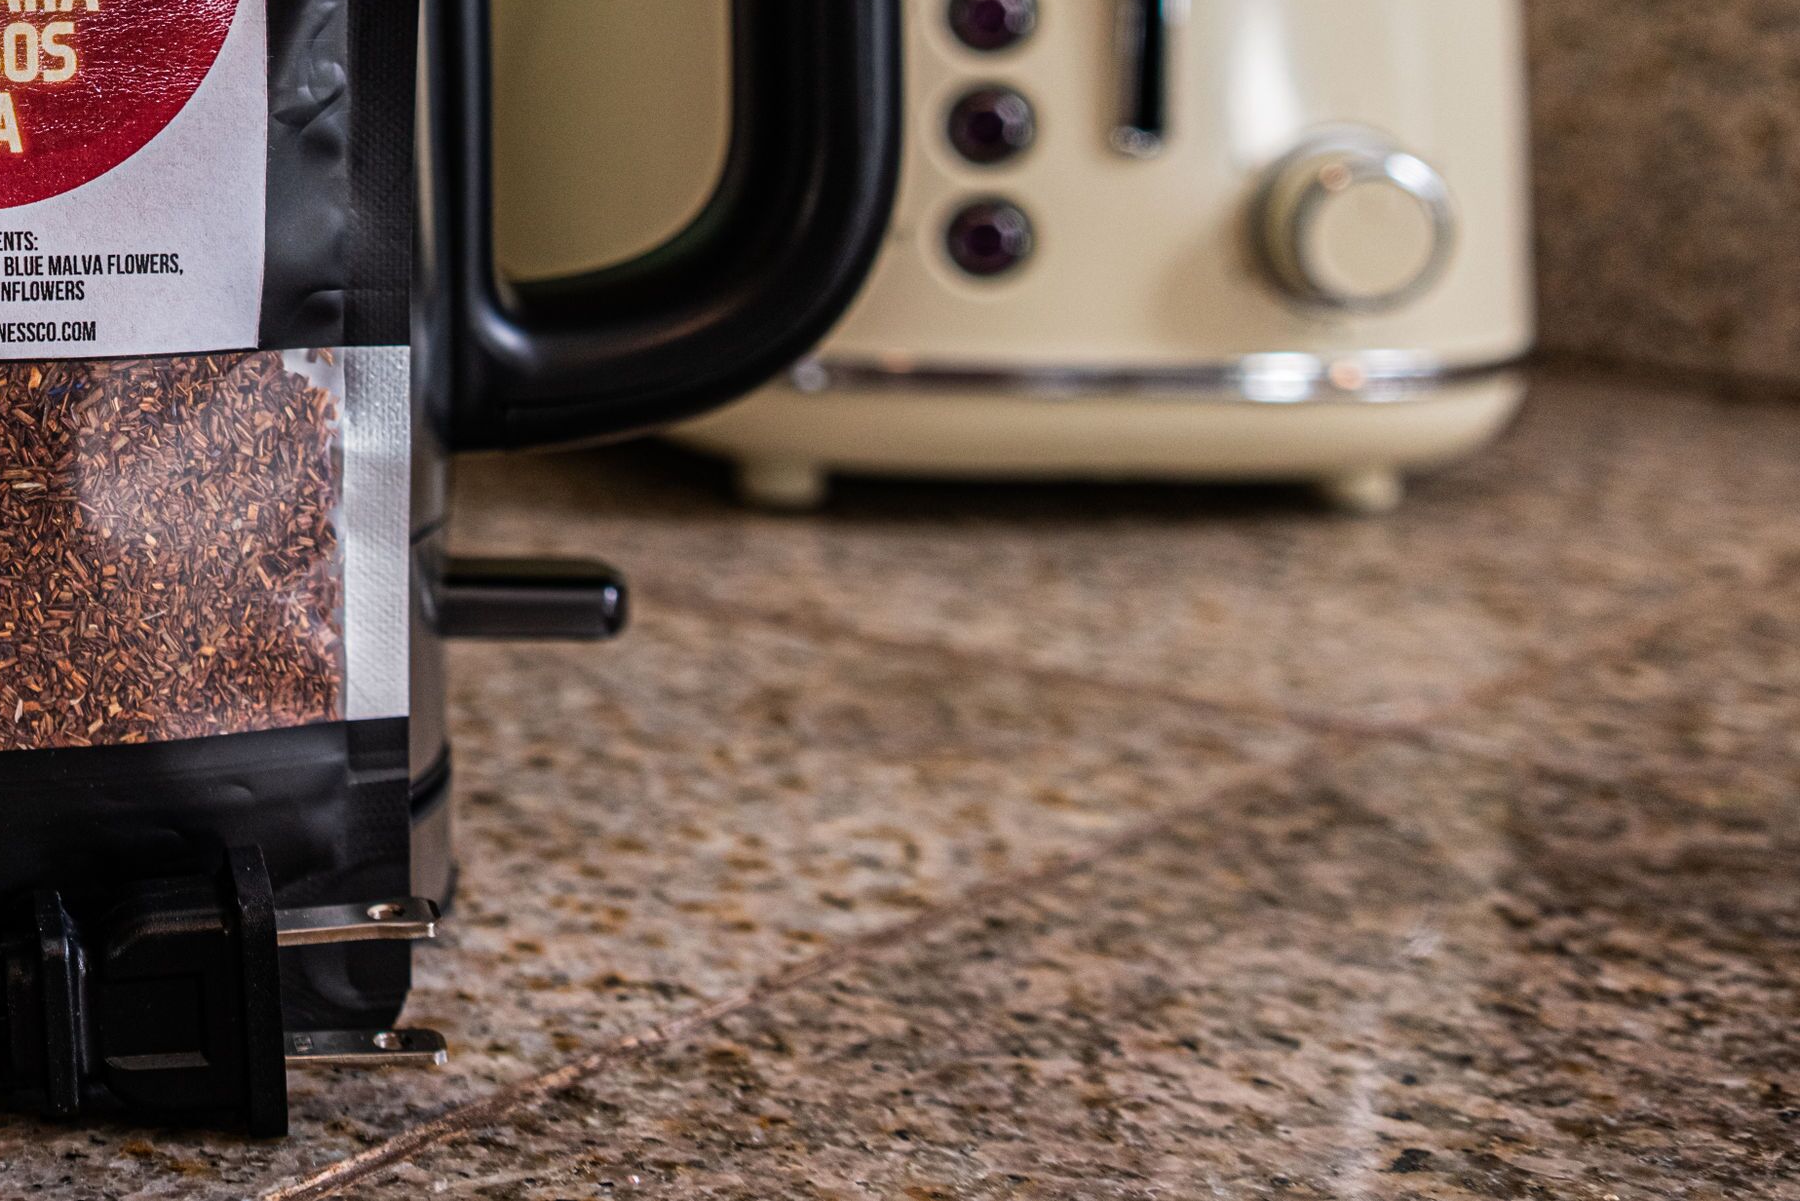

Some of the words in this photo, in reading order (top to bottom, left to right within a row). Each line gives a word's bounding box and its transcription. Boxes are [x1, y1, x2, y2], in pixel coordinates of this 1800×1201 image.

[4, 255, 44, 277] BLUE
[48, 254, 103, 276] MALVA
[107, 253, 184, 276] FLOWERS,
